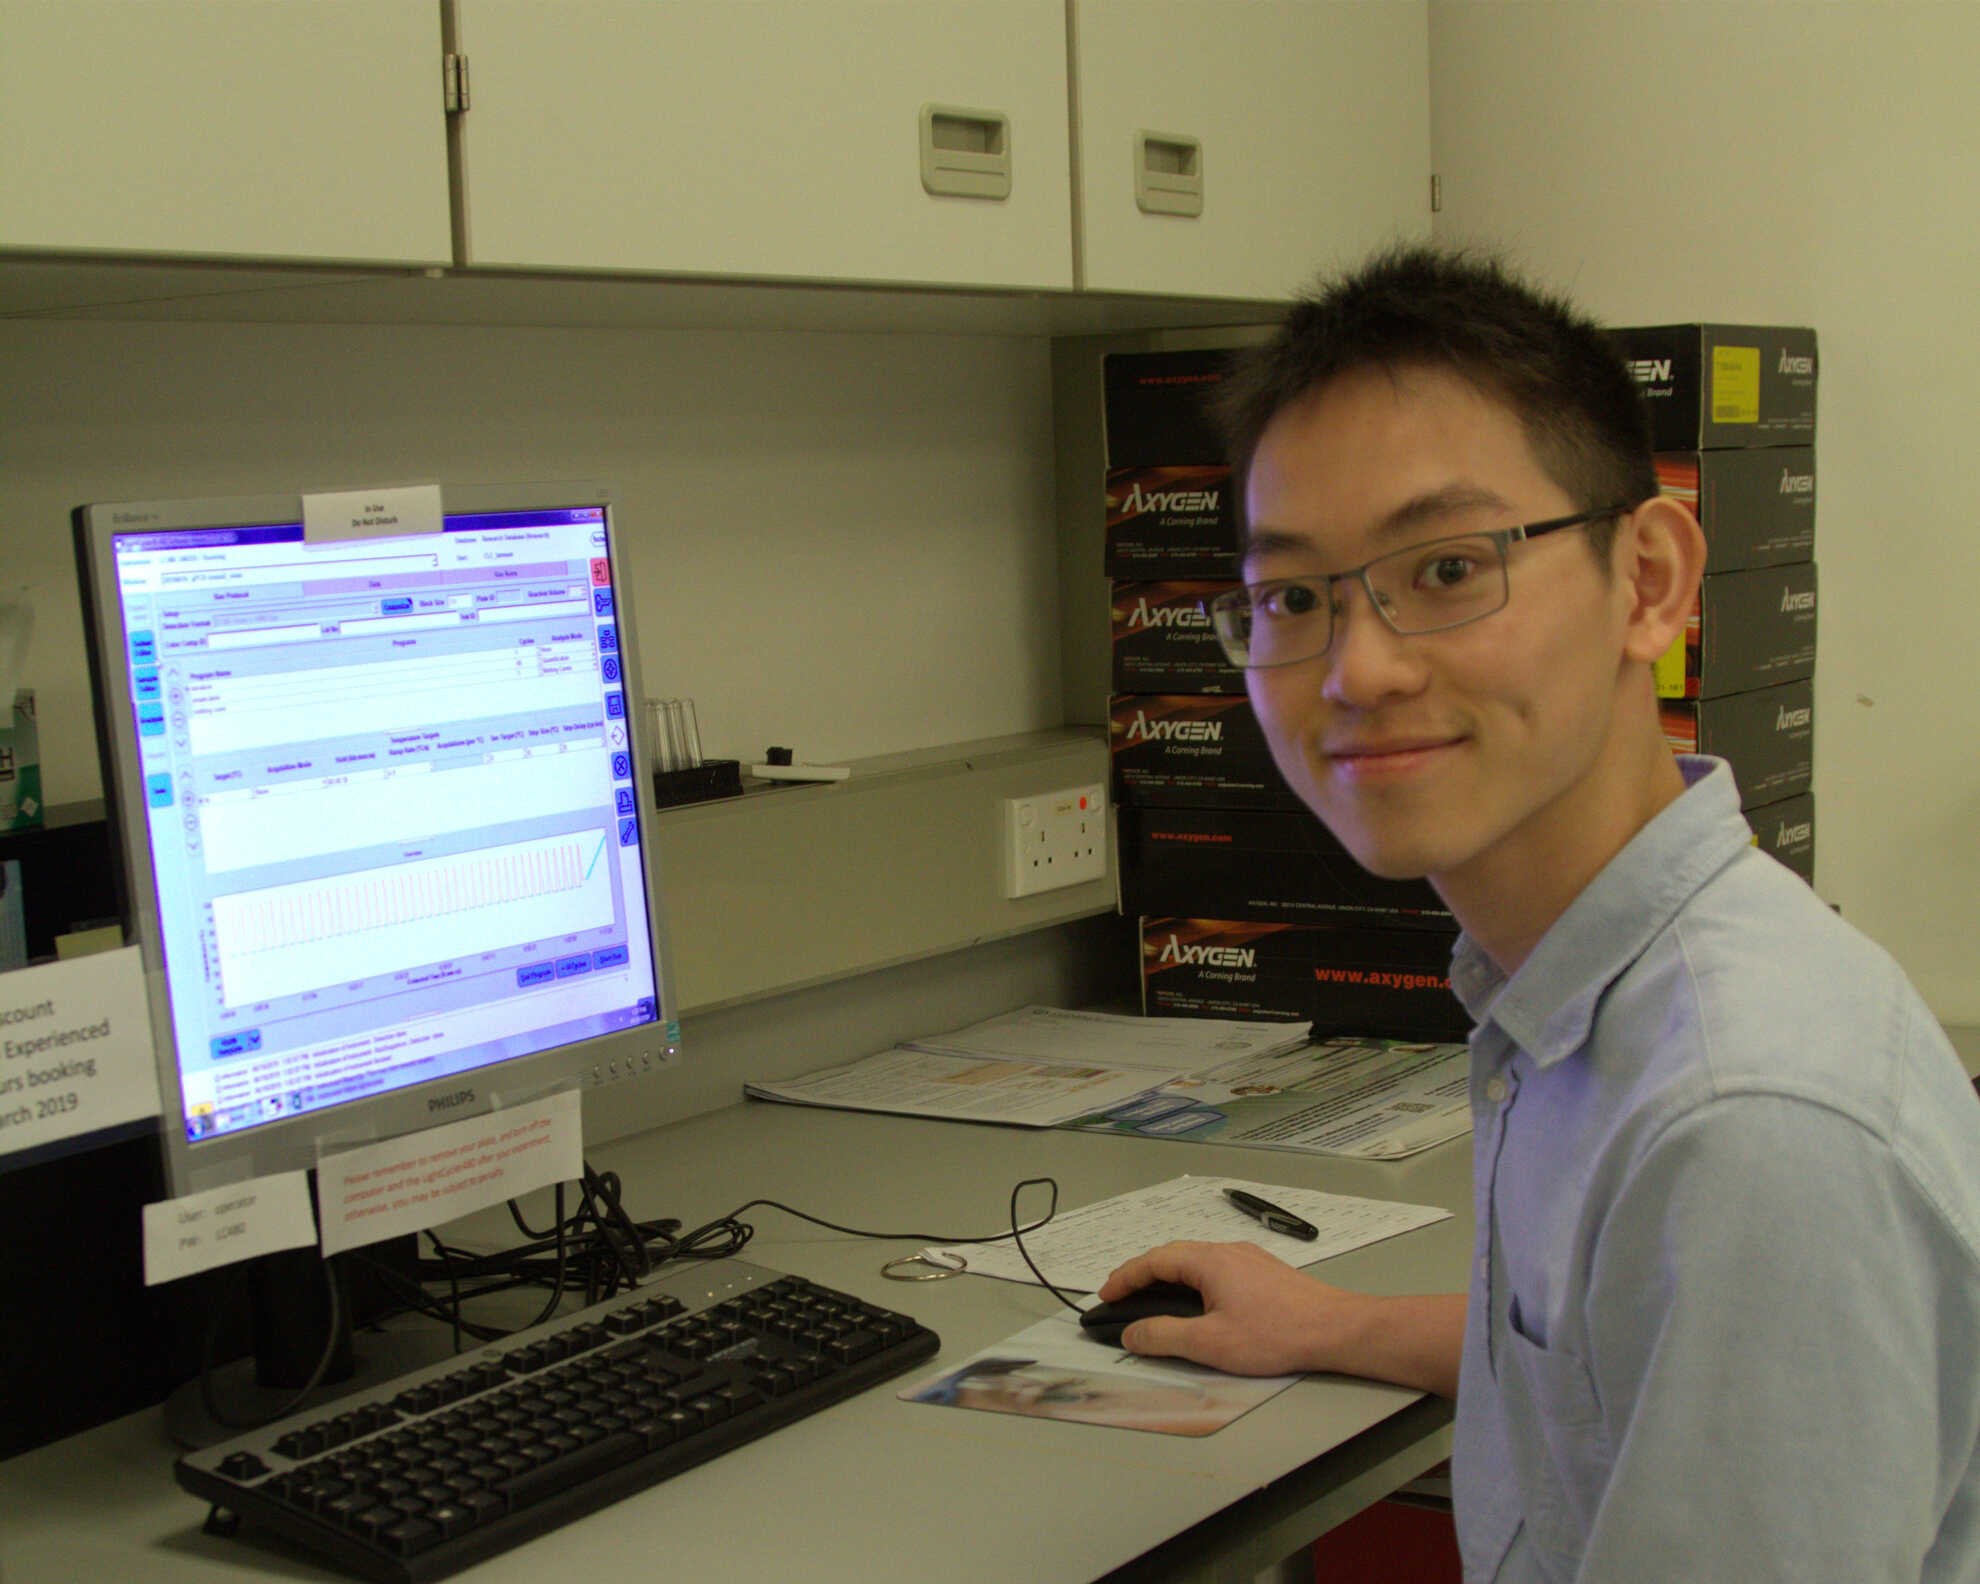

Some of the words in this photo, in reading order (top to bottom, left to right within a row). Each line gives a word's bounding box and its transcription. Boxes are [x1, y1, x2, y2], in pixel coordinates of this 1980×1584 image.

[1120, 483, 1219, 513] AXYGEN
[1126, 710, 1222, 740] AXYGEN
[1159, 934, 1256, 968] AXYGEN
[5, 1018, 110, 1060] Experienced
[27, 1058, 97, 1088] booking
[37, 1093, 78, 1119] 2019
[428, 1089, 475, 1112] PHILIPS
